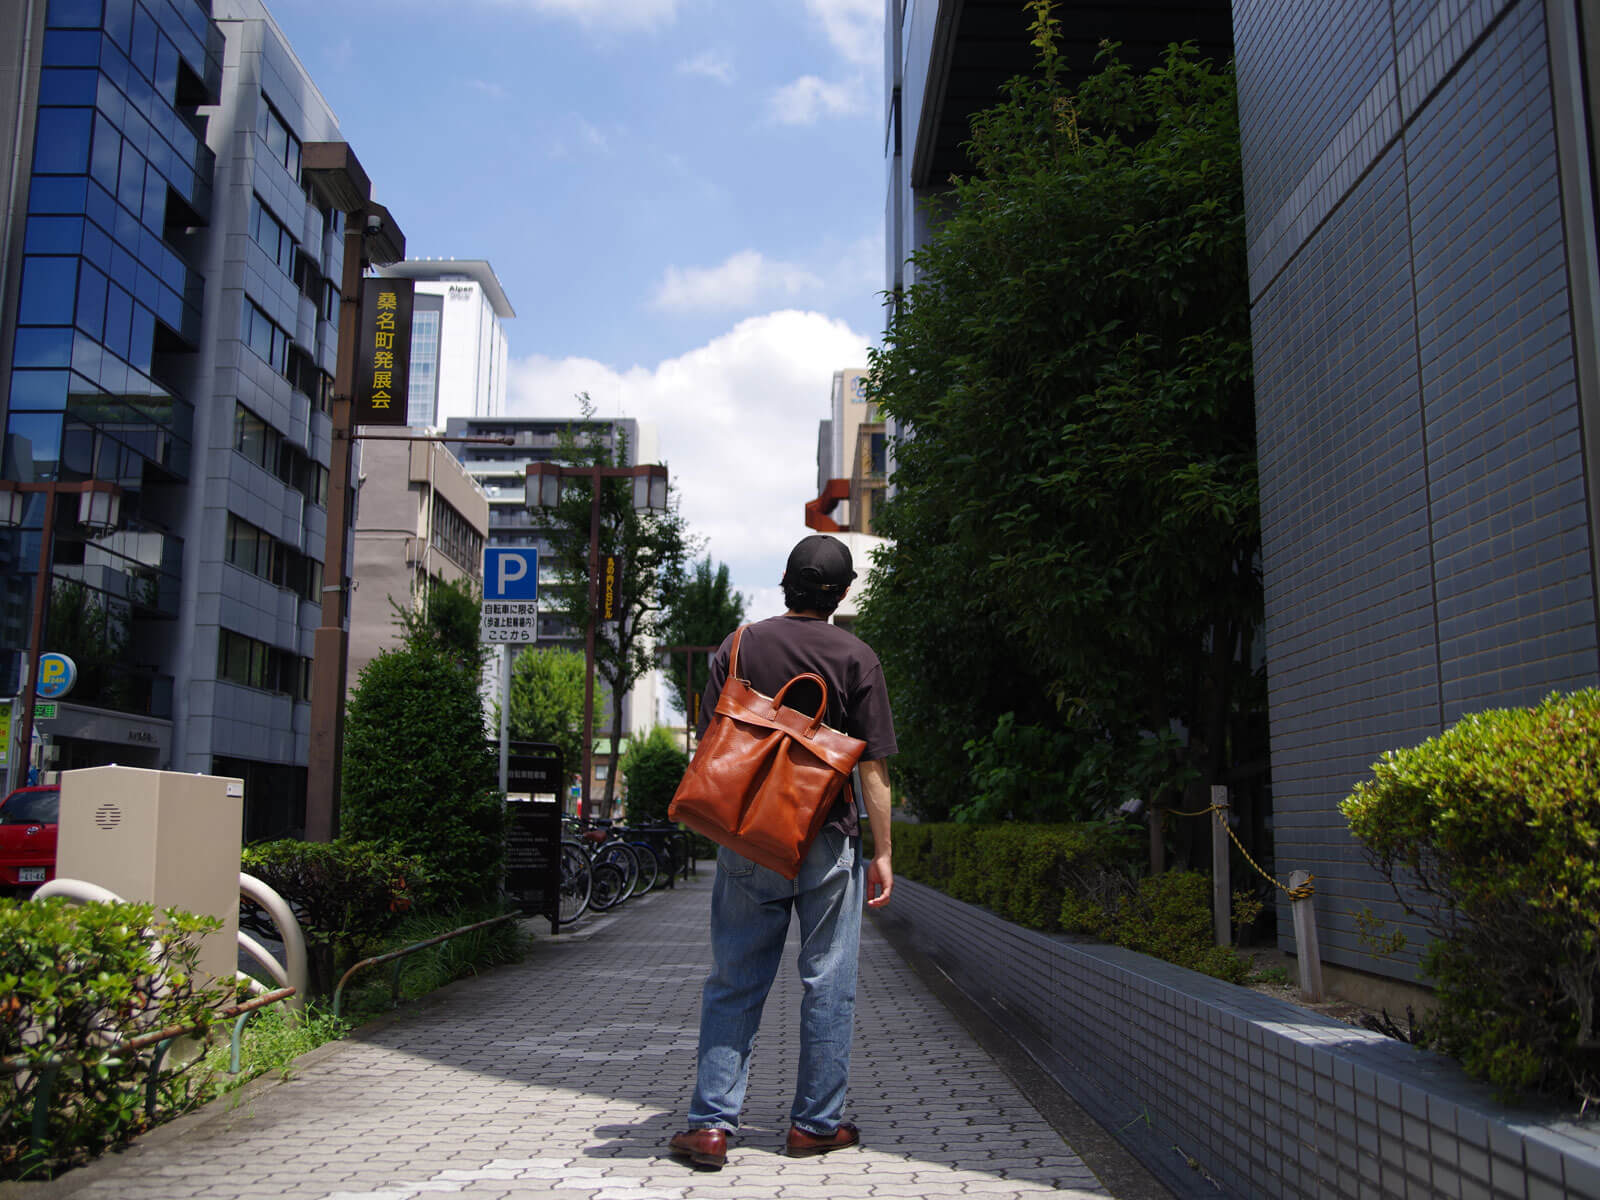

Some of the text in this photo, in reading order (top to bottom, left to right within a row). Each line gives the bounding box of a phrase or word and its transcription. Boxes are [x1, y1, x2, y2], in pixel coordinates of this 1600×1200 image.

[371, 292, 397, 409] 桑名町発展会
[497, 553, 527, 595] P
[484, 604, 535, 615] 自転車に限る
[488, 630, 530, 641] ここから
[43, 660, 65, 683] P
